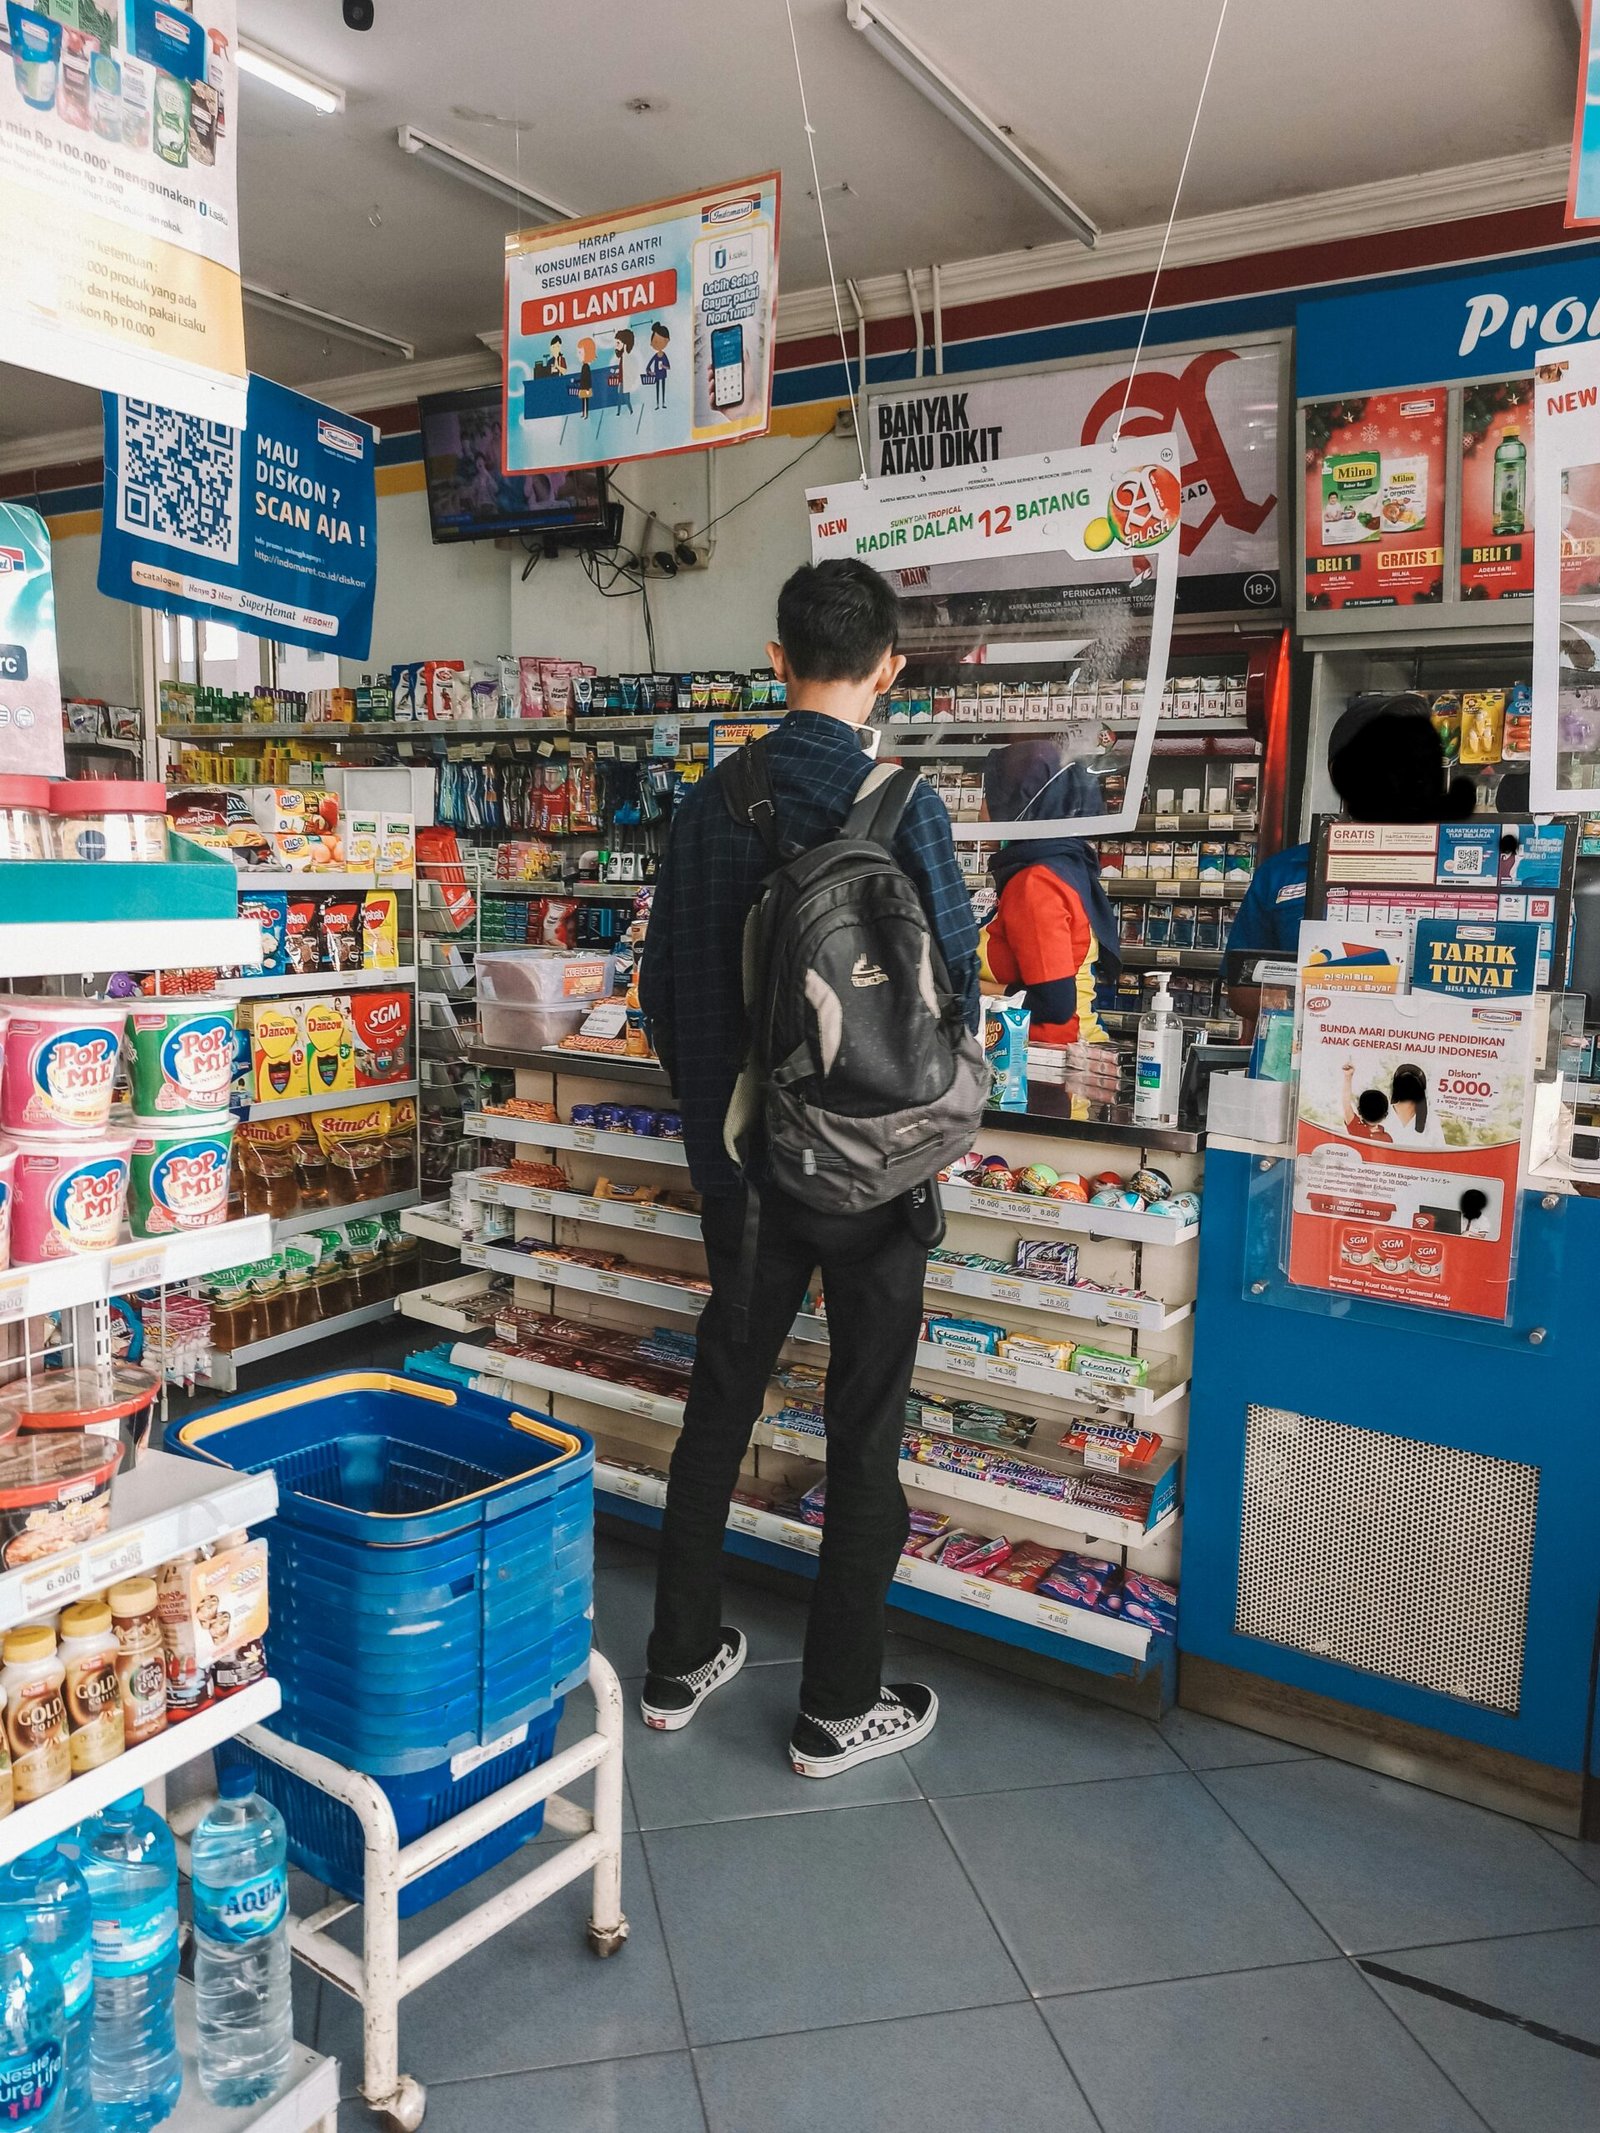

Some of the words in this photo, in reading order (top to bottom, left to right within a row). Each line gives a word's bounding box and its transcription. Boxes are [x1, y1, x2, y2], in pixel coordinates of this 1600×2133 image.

[114, 166, 196, 209] menggunakan
[713, 203, 750, 221] Indomaret
[579, 232, 616, 249] HARAP
[535, 253, 596, 275] KONSUMEN
[600, 245, 625, 260] BISA
[629, 236, 662, 255] ANTRI
[541, 271, 580, 289] SESUAI
[583, 262, 618, 281] BATAS
[621, 254, 655, 271] GARIS
[110, 269, 149, 291] produk
[151, 285, 176, 304] yang
[178, 294, 197, 309] ada
[703, 279, 730, 297] Lebih
[730, 271, 759, 289] Sehat
[88, 283, 108, 300] dan
[111, 290, 147, 312] Heboh
[149, 305, 176, 323] pakai
[543, 302, 565, 326] DI
[572, 281, 655, 322] LANTAI
[702, 296, 731, 312] Bayar
[731, 285, 759, 308] pakai
[103, 309, 118, 326] Rp
[120, 315, 155, 337] 10.000
[706, 312, 728, 326] Non
[728, 302, 756, 320] Tunai
[1458, 292, 1600, 358] Pro
[1547, 387, 1598, 416] NEW
[878, 392, 969, 441] BANYAK
[257, 433, 298, 468] MAU
[880, 432, 938, 476] ATAU
[940, 426, 1003, 468] DIKIT
[1338, 467, 1373, 480] Milna
[1392, 474, 1414, 484] Milna
[256, 461, 327, 505] DISKON
[331, 488, 340, 510] ?
[1389, 488, 1416, 498] organic
[255, 491, 310, 531] SCAN
[316, 513, 353, 546] AJA
[856, 528, 908, 554] HADIR
[912, 512, 974, 542] DALAM
[978, 505, 1013, 538] 12
[1016, 488, 1091, 521] BATANG
[890, 516, 914, 528] SUNNY
[914, 514, 927, 523] DAN
[927, 505, 962, 520] TROPICAL
[817, 518, 848, 539] NEW
[1123, 517, 1171, 550] SPLASH
[1381, 550, 1427, 568] GRATIS
[1431, 550, 1438, 563] 1
[1472, 547, 1501, 563] BELI
[1504, 546, 1512, 560] 1
[1316, 557, 1343, 572] BELI
[1344, 557, 1352, 571] 1
[136, 569, 181, 589] e-catalogue
[210, 588, 217, 600] 3
[239, 595, 296, 621] SuperHemat
[1062, 587, 1121, 599] PERINGATAN:
[1247, 581, 1272, 596] 18+
[552, 686, 569, 694] Hand
[726, 728, 755, 738] WEEK
[280, 793, 301, 807] nice
[175, 816, 198, 826] Abon
[199, 813, 216, 822] Sapi
[1334, 829, 1375, 839] GRATIS
[283, 837, 305, 850] nice
[1429, 941, 1517, 965] TARIK
[1323, 973, 1334, 981] Di
[1335, 973, 1353, 981] Sini
[1353, 973, 1375, 981] Bisa
[1364, 983, 1392, 993] Bayar
[1444, 985, 1465, 994] BISA
[1467, 986, 1478, 994] DI
[1479, 986, 1497, 995] SINI
[1308, 998, 1330, 1008] SGM
[369, 1001, 401, 1028] SGM
[1481, 1012, 1514, 1021] Indomaret
[259, 1023, 298, 1039] Dancow
[307, 1018, 343, 1033] Dancow
[1320, 1023, 1356, 1035] BUNDA
[1359, 1026, 1386, 1037] MARI
[1388, 1028, 1436, 1042] DUKUNG
[1438, 1032, 1505, 1047] PENDIDIKAN
[340, 1047, 351, 1058] 3+
[1321, 1036, 1350, 1048] ANAK
[1353, 1038, 1402, 1052] GENERASI
[1405, 1041, 1436, 1054] MAJU
[1438, 1044, 1499, 1059] INDONESIA
[192, 1043, 233, 1075] MIE
[66, 1063, 113, 1089] MIE
[1438, 1078, 1499, 1098] 5.000,-
[321, 1110, 381, 1134] Bimoli
[238, 1122, 291, 1141] Bimoli
[1326, 1149, 1349, 1158] Donasi
[179, 1167, 224, 1200] MIE
[1357, 1168, 1382, 1177] 2x900gr
[1382, 1170, 1397, 1178] SGM
[1397, 1172, 1419, 1181] Eksplor
[1379, 1177, 1387, 1185] Rp
[977, 1198, 1000, 1209] 10.000
[1008, 1204, 1031, 1214] 10.000
[1040, 1209, 1060, 1218] 8.800
[1366, 1209, 1381, 1217] 2020
[1349, 1236, 1368, 1244] SGM
[1382, 1239, 1404, 1249] SGM
[1417, 1247, 1437, 1256] SGM
[997, 1288, 1021, 1299] 18.800
[1365, 1281, 1380, 1290] Kuat
[1380, 1283, 1405, 1294] Dukung
[1405, 1287, 1434, 1299] Generasi
[1434, 1293, 1451, 1302] Maju
[1113, 1310, 1138, 1321] 18.800
[953, 1357, 976, 1368] 14.300
[994, 1366, 1017, 1377] 14.300
[1071, 1420, 1139, 1445] mentos
[1096, 1453, 1118, 1464] 3.300
[938, 1460, 981, 1481] mentos
[110, 1550, 142, 1570] 6.900
[46, 1568, 81, 1591] 6.900
[971, 1589, 991, 1600] 4.800
[1047, 1613, 1068, 1625] 4.800
[76, 1674, 116, 1700] GOLD
[18, 1697, 62, 1727] GOLD
[224, 1877, 282, 1918] AQUA
[38, 2055, 62, 2089] Life
